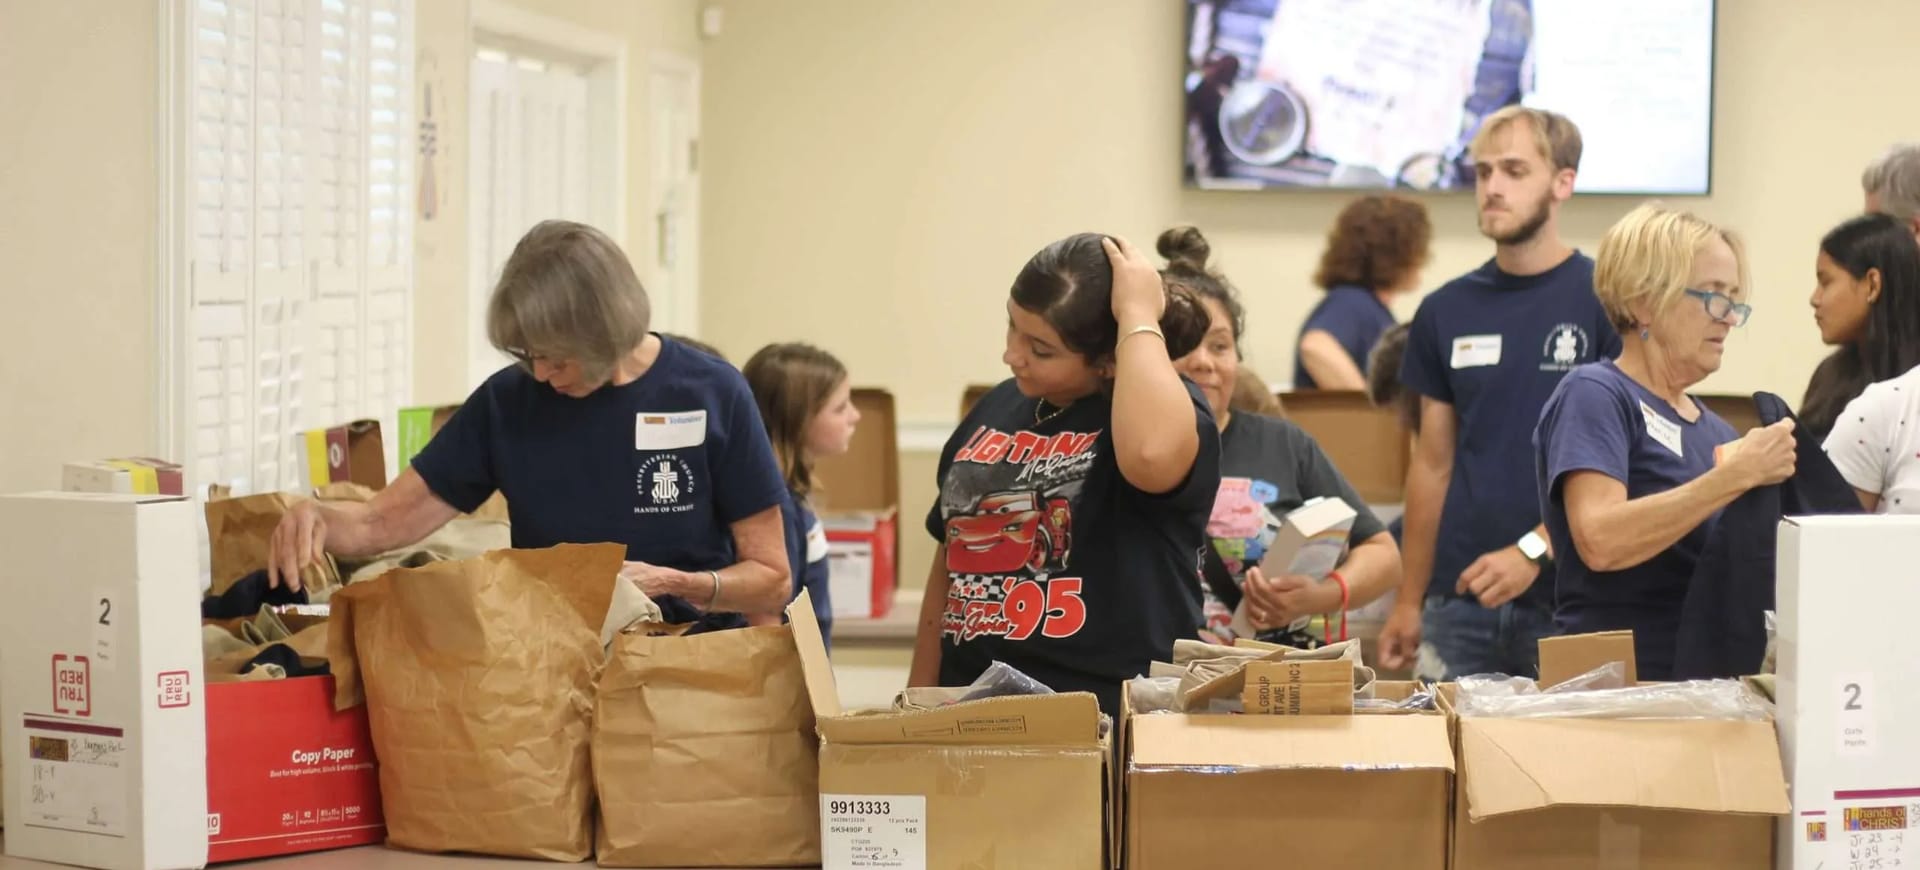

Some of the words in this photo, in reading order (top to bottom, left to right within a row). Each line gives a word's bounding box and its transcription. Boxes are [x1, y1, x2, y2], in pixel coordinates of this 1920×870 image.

[634, 506, 660, 514] HANDS
[98, 597, 111, 626] 2
[59, 669, 84, 685] RED
[1288, 669, 1301, 683] NC
[60, 685, 85, 702] TRU
[165, 678, 174, 702] TRU
[174, 677, 183, 701] RED
[1259, 675, 1271, 707] GROUP
[1274, 686, 1286, 704] AVE
[1844, 683, 1862, 711] 2
[292, 749, 321, 766] Copy
[323, 747, 355, 763] Paper
[831, 800, 890, 814] 9913333
[1860, 809, 1893, 819] hands
